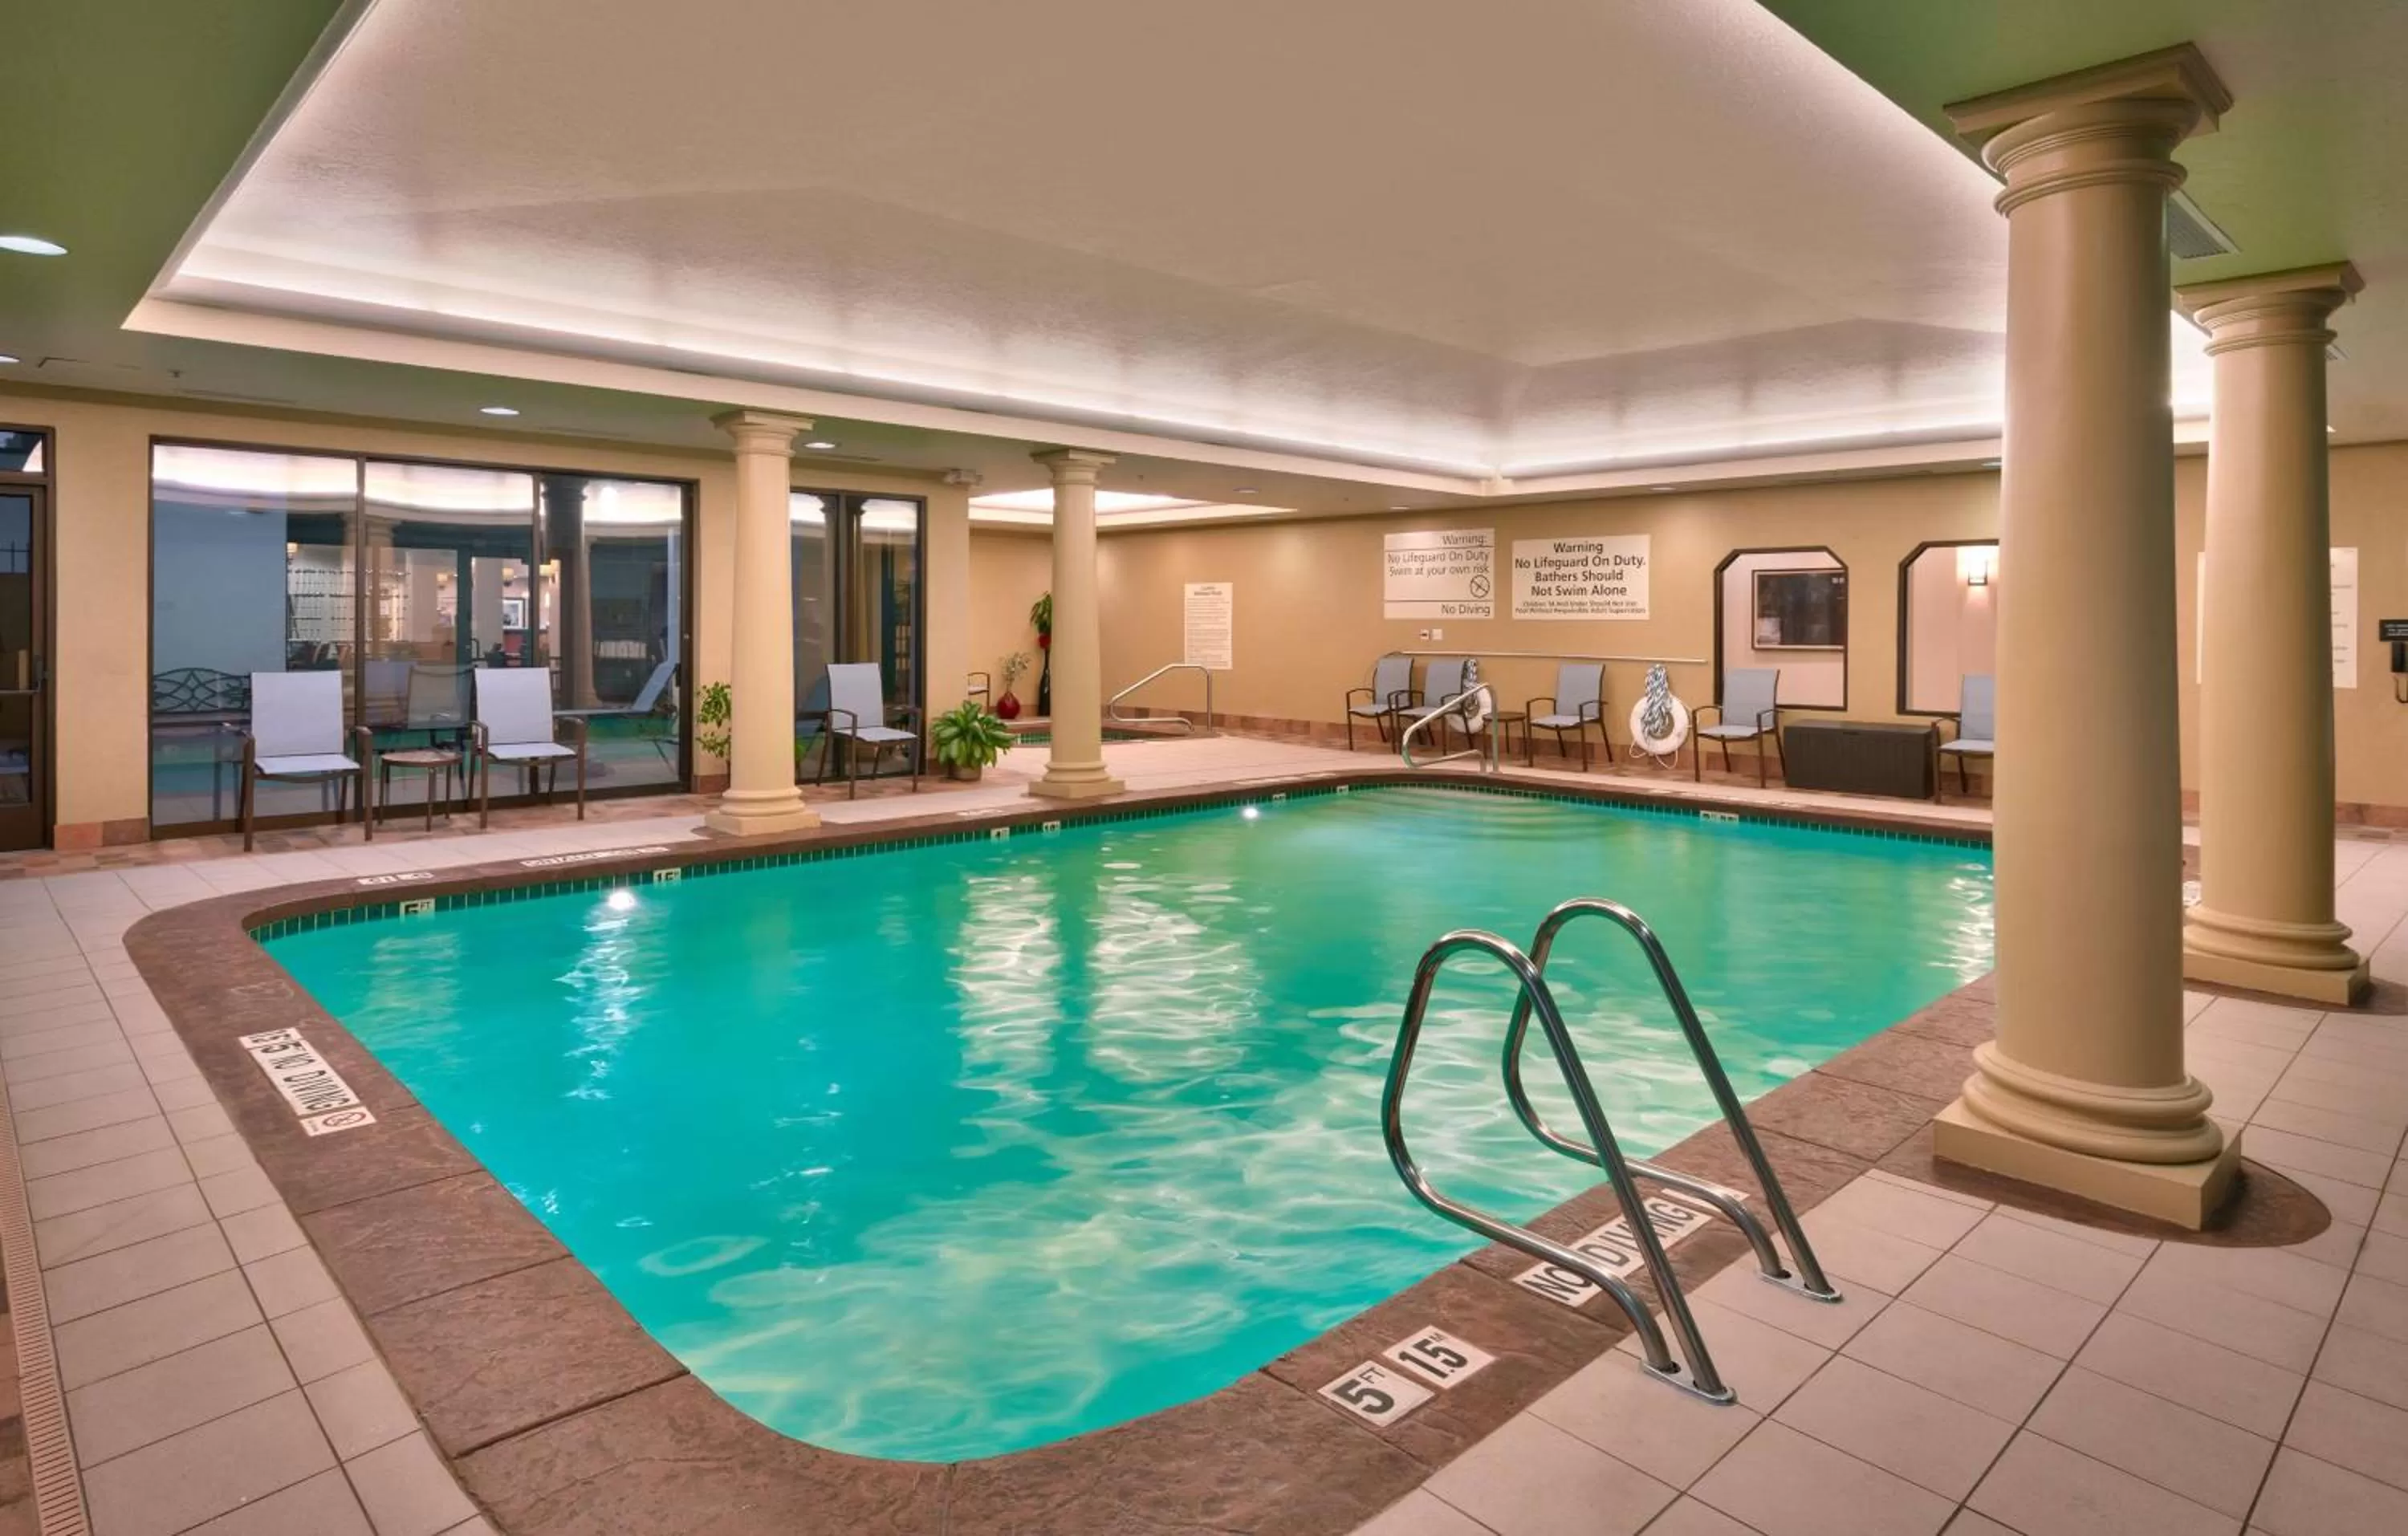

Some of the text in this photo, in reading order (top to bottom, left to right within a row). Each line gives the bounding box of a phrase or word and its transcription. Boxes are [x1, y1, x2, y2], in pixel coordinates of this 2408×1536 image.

[1554, 542, 1604, 554] Warning
[1388, 551, 1491, 565] No Lifeguard On Duty
[1515, 559, 1531, 568] No
[1534, 556, 1588, 570] Lifeguard
[1592, 555, 1609, 567] On
[1389, 563, 1490, 579] Swim at your own risk
[1535, 569, 1624, 582] Bathers Should
[1531, 584, 1628, 596] Not Swim Alone
[1442, 603, 1491, 617] No Diving
[1522, 1266, 1593, 1301] NO
[1332, 1367, 1395, 1414] 5 FT
